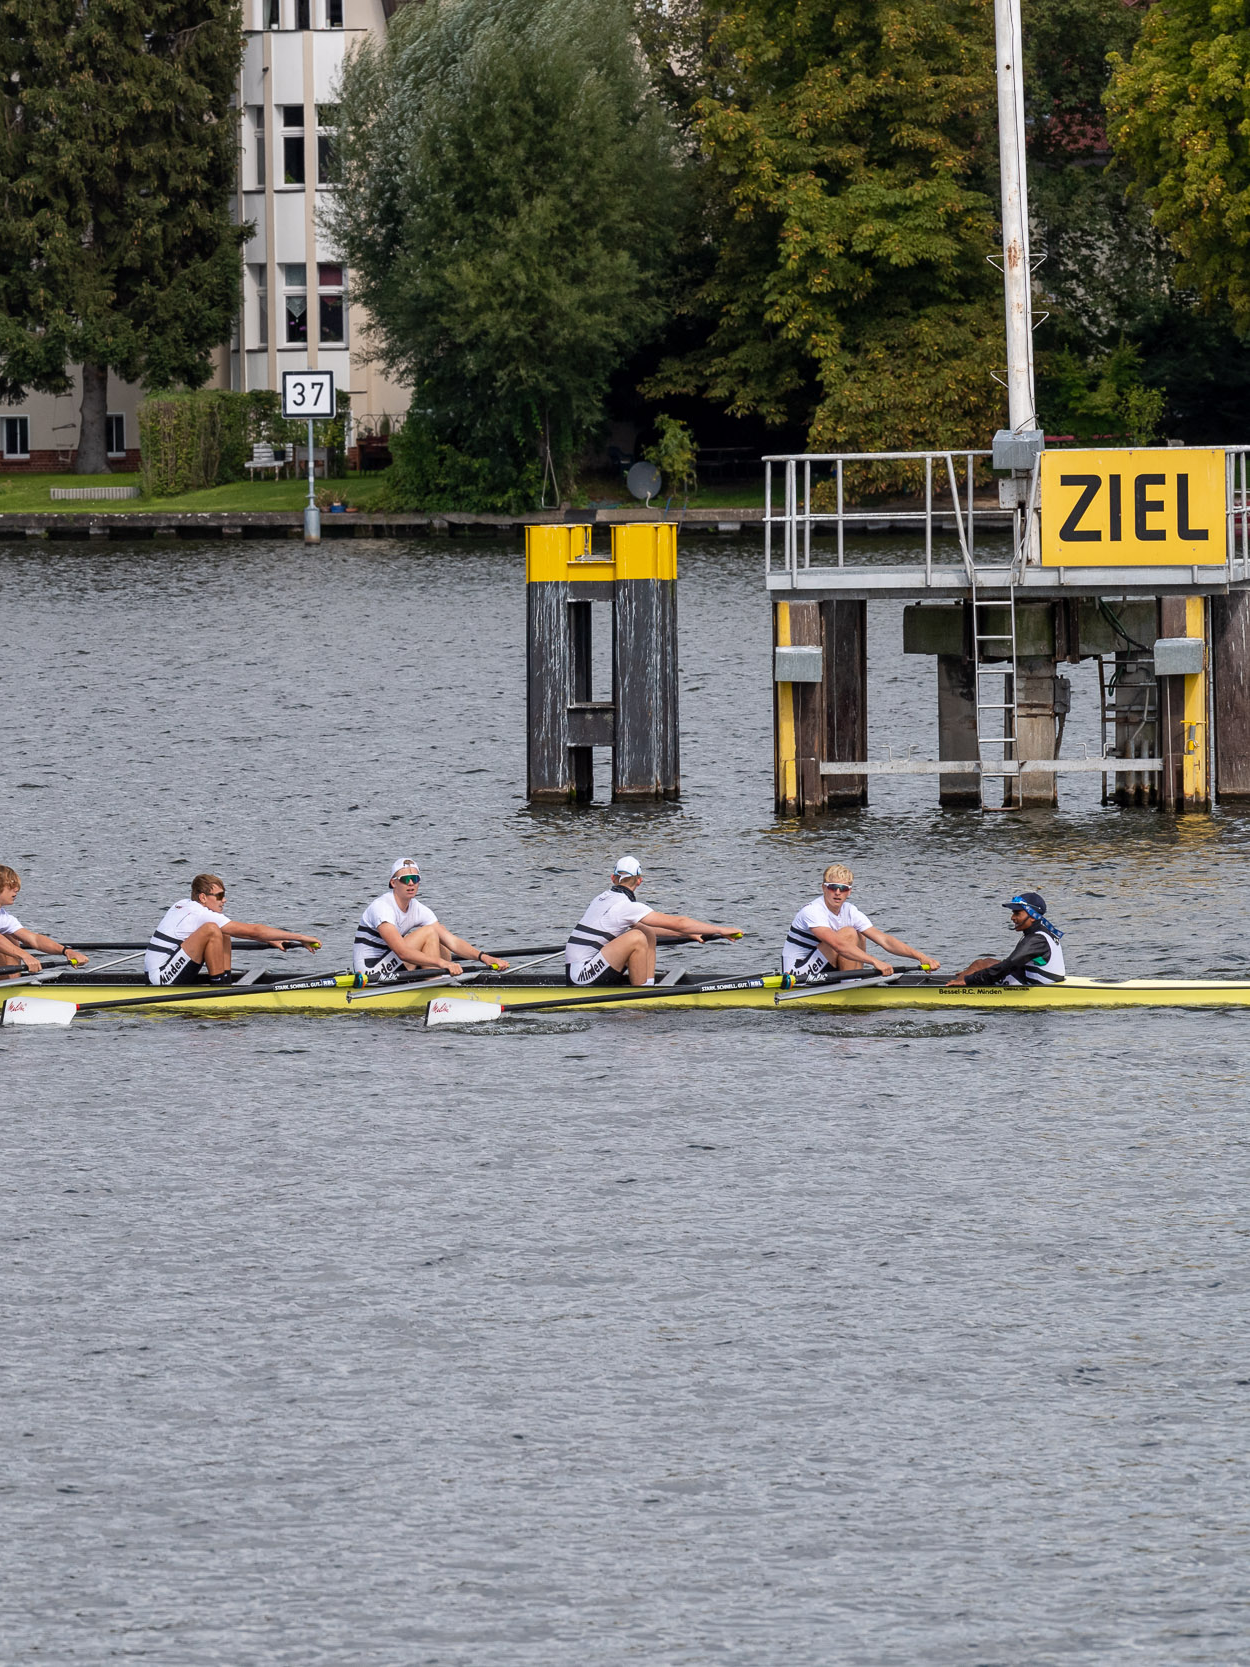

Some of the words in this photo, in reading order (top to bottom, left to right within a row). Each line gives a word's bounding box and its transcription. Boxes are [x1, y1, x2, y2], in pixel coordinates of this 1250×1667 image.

[292, 382, 324, 406] 37
[1059, 473, 1209, 542] ZIEL
[159, 956, 186, 985] Minden
